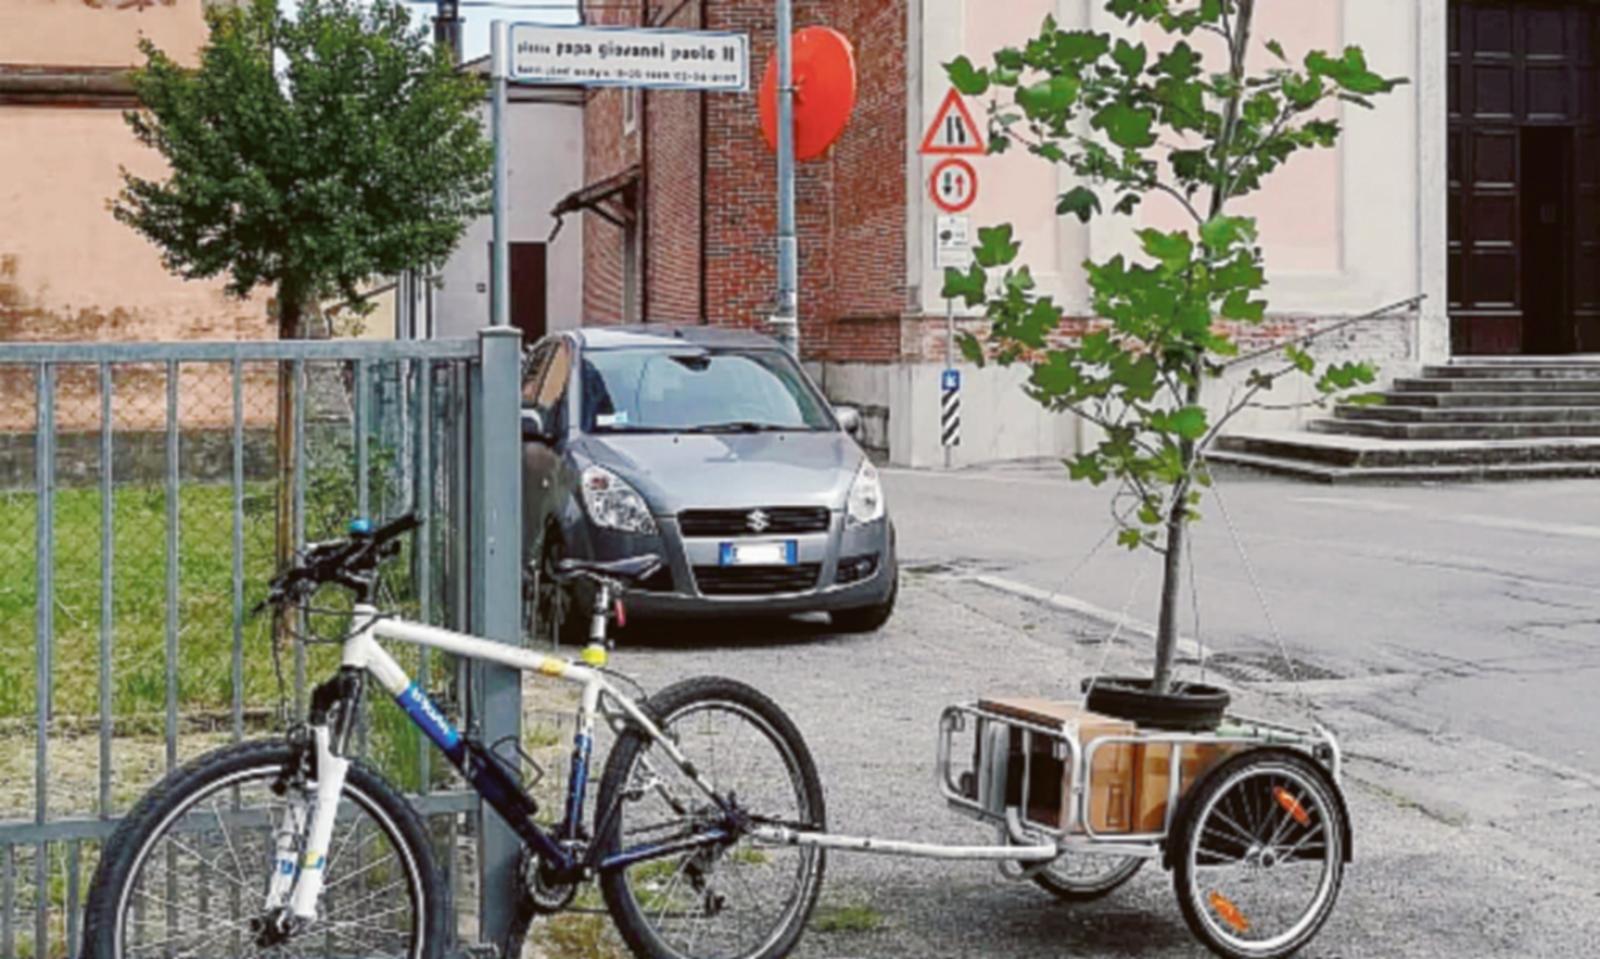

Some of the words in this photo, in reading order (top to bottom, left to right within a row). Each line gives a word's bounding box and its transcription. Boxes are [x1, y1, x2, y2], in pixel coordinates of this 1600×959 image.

[556, 42, 592, 58] papa
[598, 40, 665, 60] giovanni
[670, 45, 716, 62] paolo
